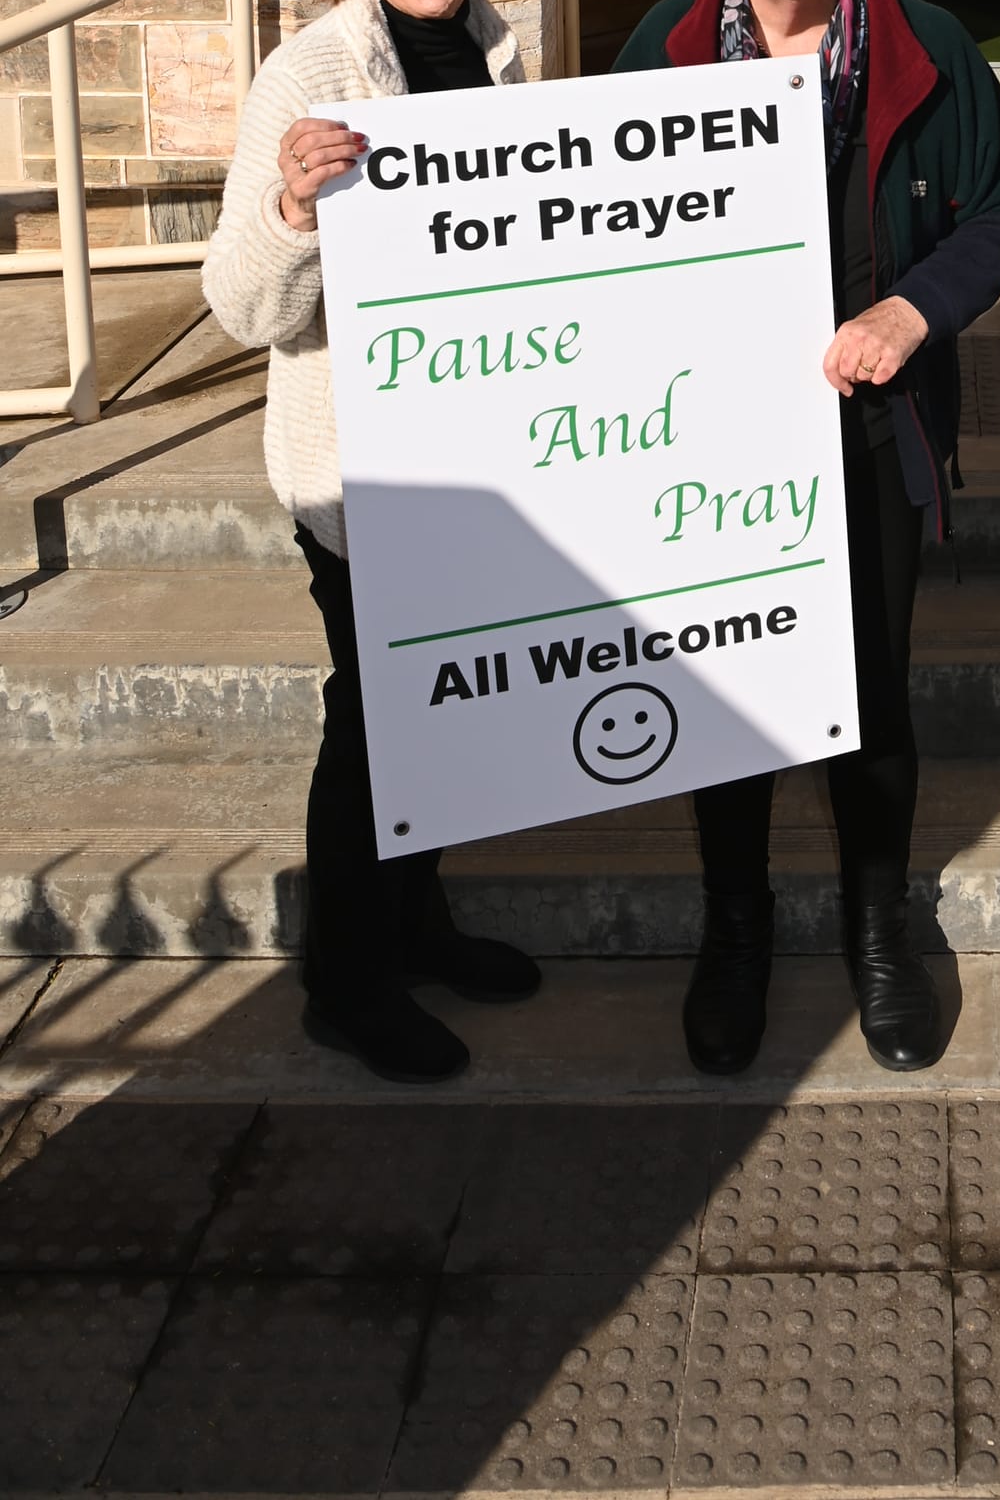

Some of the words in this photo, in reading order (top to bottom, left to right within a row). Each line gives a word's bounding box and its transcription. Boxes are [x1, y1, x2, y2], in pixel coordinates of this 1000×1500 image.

[367, 127, 592, 191] Church
[614, 104, 779, 162] OPEN
[428, 211, 517, 255] for
[538, 187, 735, 241] Prayer
[367, 322, 581, 390] Pause
[529, 369, 692, 468] And
[655, 475, 819, 552] Pray
[429, 652, 509, 706] All
[528, 606, 797, 684] Welcome
